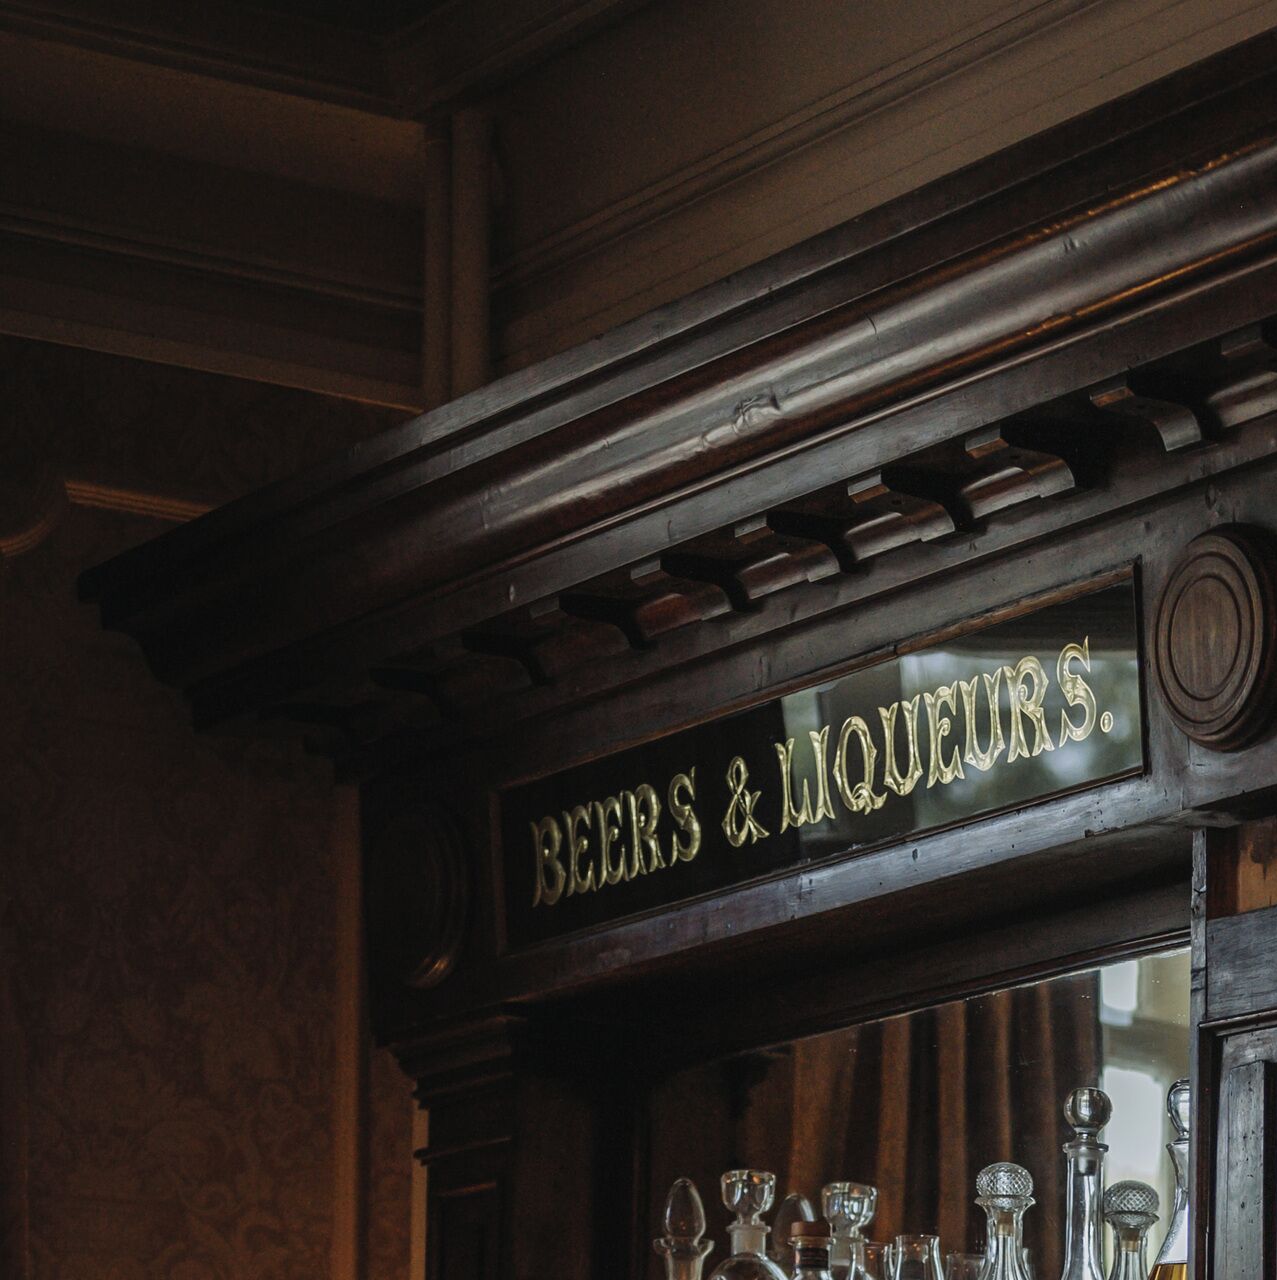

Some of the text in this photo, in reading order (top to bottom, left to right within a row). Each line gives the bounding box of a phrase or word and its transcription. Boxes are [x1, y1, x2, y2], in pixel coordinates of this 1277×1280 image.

[530, 635, 1114, 907] BEERS & LIQUEURS.
